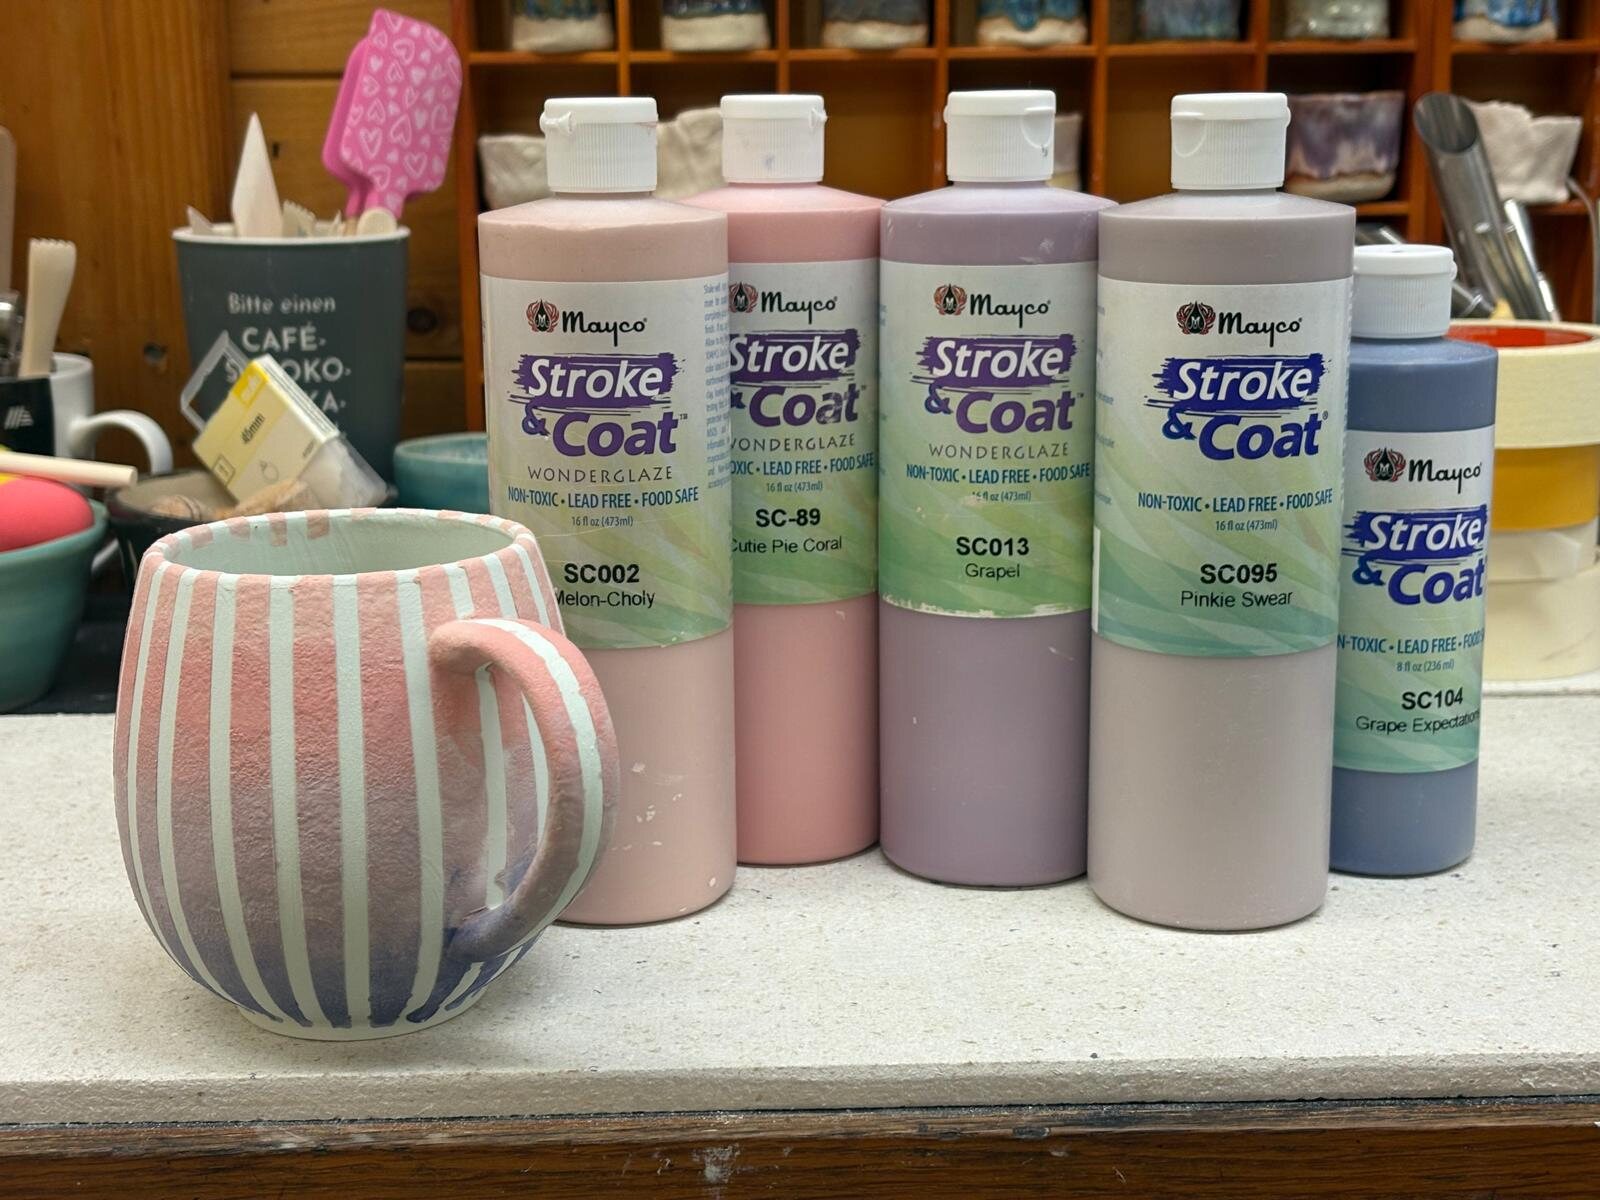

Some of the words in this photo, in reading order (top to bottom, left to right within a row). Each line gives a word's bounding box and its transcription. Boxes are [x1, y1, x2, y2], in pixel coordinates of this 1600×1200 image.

[228, 292, 273, 314] Bitte
[280, 295, 336, 313] einen
[730, 336, 849, 373] Stroke
[932, 340, 1063, 378] Stroke
[528, 358, 663, 398] Stroke
[1173, 361, 1312, 401] Stroke
[924, 381, 953, 414] &
[522, 400, 550, 435] &
[1162, 403, 1197, 440] &
[929, 442, 1069, 460] WONDERGLAZE
[763, 461, 792, 475] LEAD
[795, 460, 821, 474] FREE
[830, 456, 855, 472] FOOD
[857, 452, 874, 469] SAFE
[906, 464, 959, 483] NON-TOXIC
[969, 469, 999, 484] LEAD
[1002, 468, 1030, 483] FREE
[1039, 465, 1068, 482] FOOD
[1070, 462, 1090, 478] SAFE
[528, 466, 672, 483] WONDERGLAZE
[508, 486, 559, 507] NON-TOXIC
[568, 493, 599, 508] LEAD
[602, 493, 632, 508] FREE
[642, 490, 673, 507] FOOD
[675, 486, 699, 504] SAFE
[767, 483, 776, 492] 16
[776, 482, 783, 492] fl
[794, 481, 823, 493] (473ml)
[972, 491, 981, 501] 6
[990, 493, 999, 501] oz
[1001, 490, 1032, 502] (473ml)
[1138, 492, 1202, 512] NON-TOXIC
[1213, 496, 1245, 513] LEAD
[1248, 496, 1278, 511] FREE
[1286, 492, 1313, 510] FOOD
[1314, 488, 1333, 506] SAFE
[572, 516, 581, 526] 16
[582, 515, 589, 526] fl
[590, 518, 600, 526] oz
[601, 516, 633, 527] (473ml)
[756, 508, 821, 527] SC-89
[1216, 521, 1226, 531] 16
[1226, 520, 1233, 531] fl
[1235, 523, 1245, 531] oz
[1246, 519, 1278, 532] (473ml)
[1364, 514, 1482, 550] Stroke
[731, 538, 767, 553] Cutie
[772, 539, 798, 553] Pie
[803, 536, 842, 552] Coral
[956, 536, 1030, 556] SC013
[563, 563, 640, 584] SC002
[965, 563, 1020, 581] Grapel
[1200, 563, 1278, 584] SC095
[1352, 555, 1385, 585] &
[1388, 559, 1485, 606] Coat
[555, 590, 655, 608] Melon-Choly
[1181, 590, 1236, 608] Pinkie
[1241, 591, 1293, 607] Swear
[1337, 634, 1386, 653] N-TOXIC
[1397, 639, 1429, 654] LEAD
[1431, 636, 1457, 653] FREE
[1396, 662, 1402, 672] 8
[1404, 661, 1411, 671] fl
[1424, 661, 1442, 673] (236
[1401, 687, 1463, 710] SC104
[1356, 716, 1407, 735] Grape
[1413, 708, 1480, 734] Expectation
